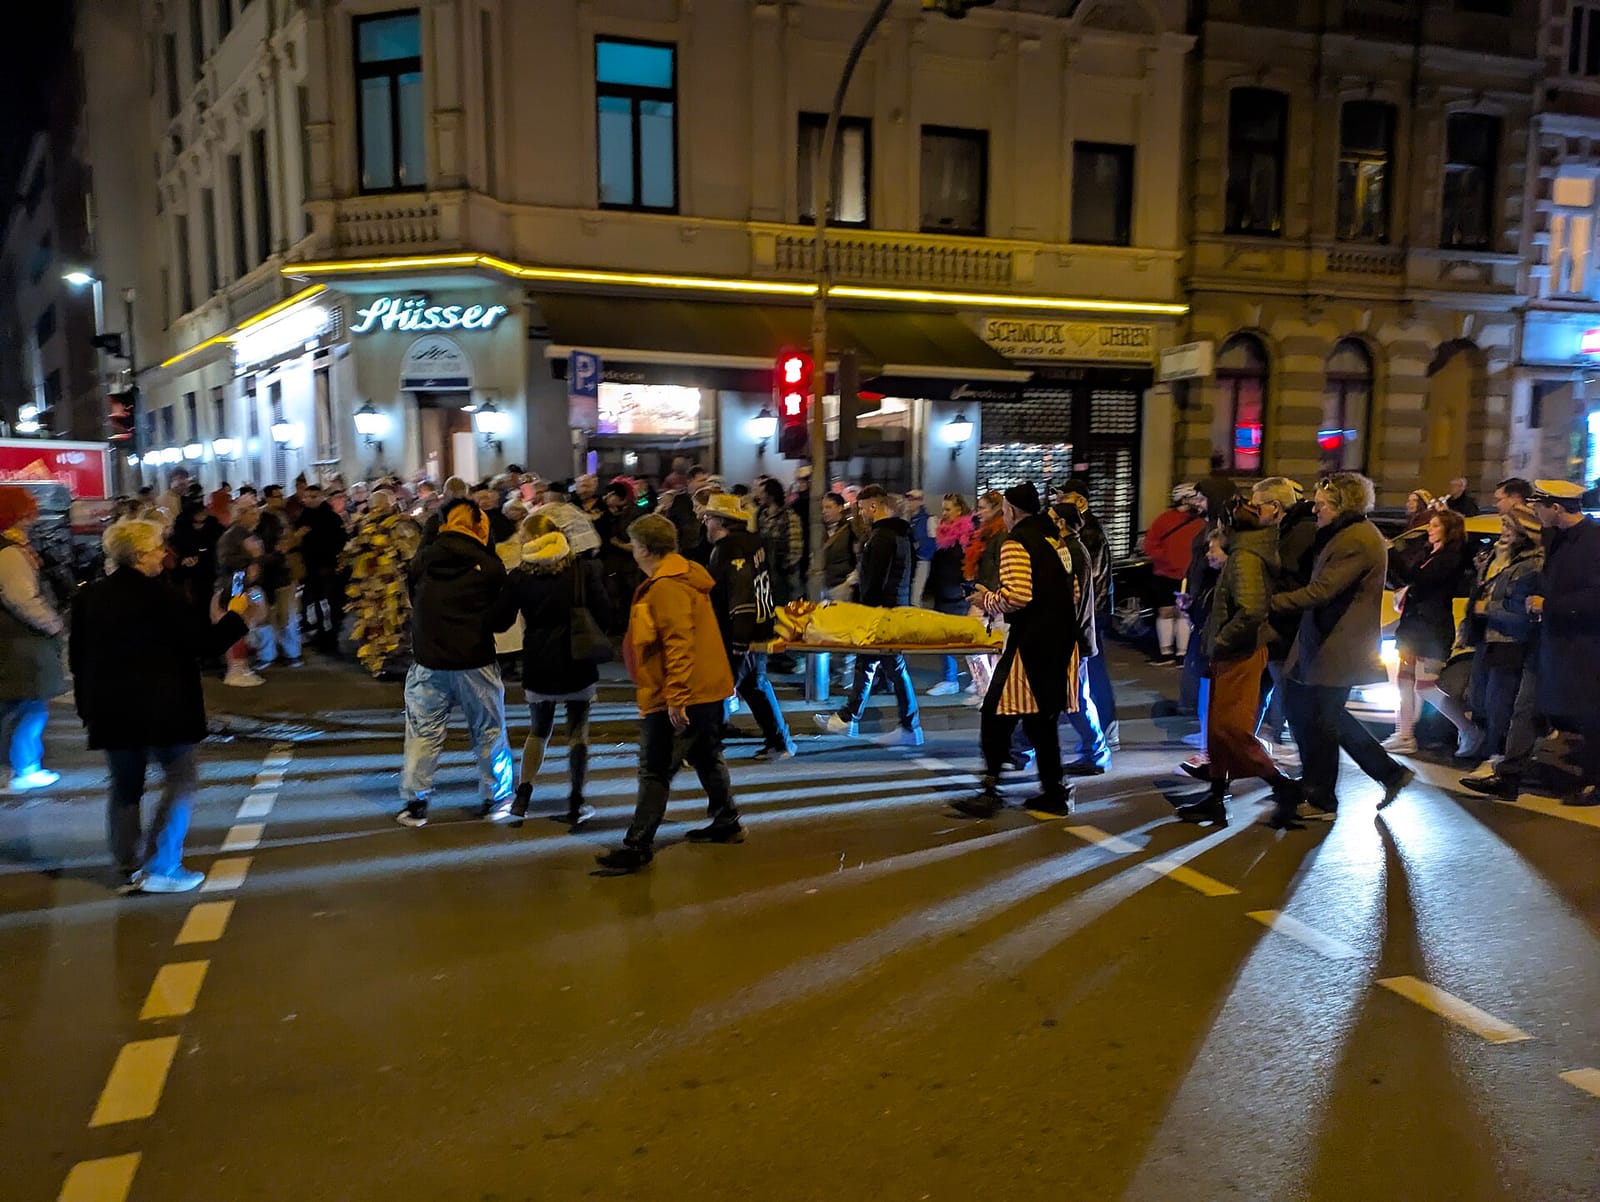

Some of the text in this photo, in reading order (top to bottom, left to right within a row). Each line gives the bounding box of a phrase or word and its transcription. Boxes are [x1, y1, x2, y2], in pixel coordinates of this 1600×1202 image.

[348, 296, 508, 334] Stüsser
[986, 320, 1152, 347] SCHMUCK UHREN
[575, 354, 596, 391] P
